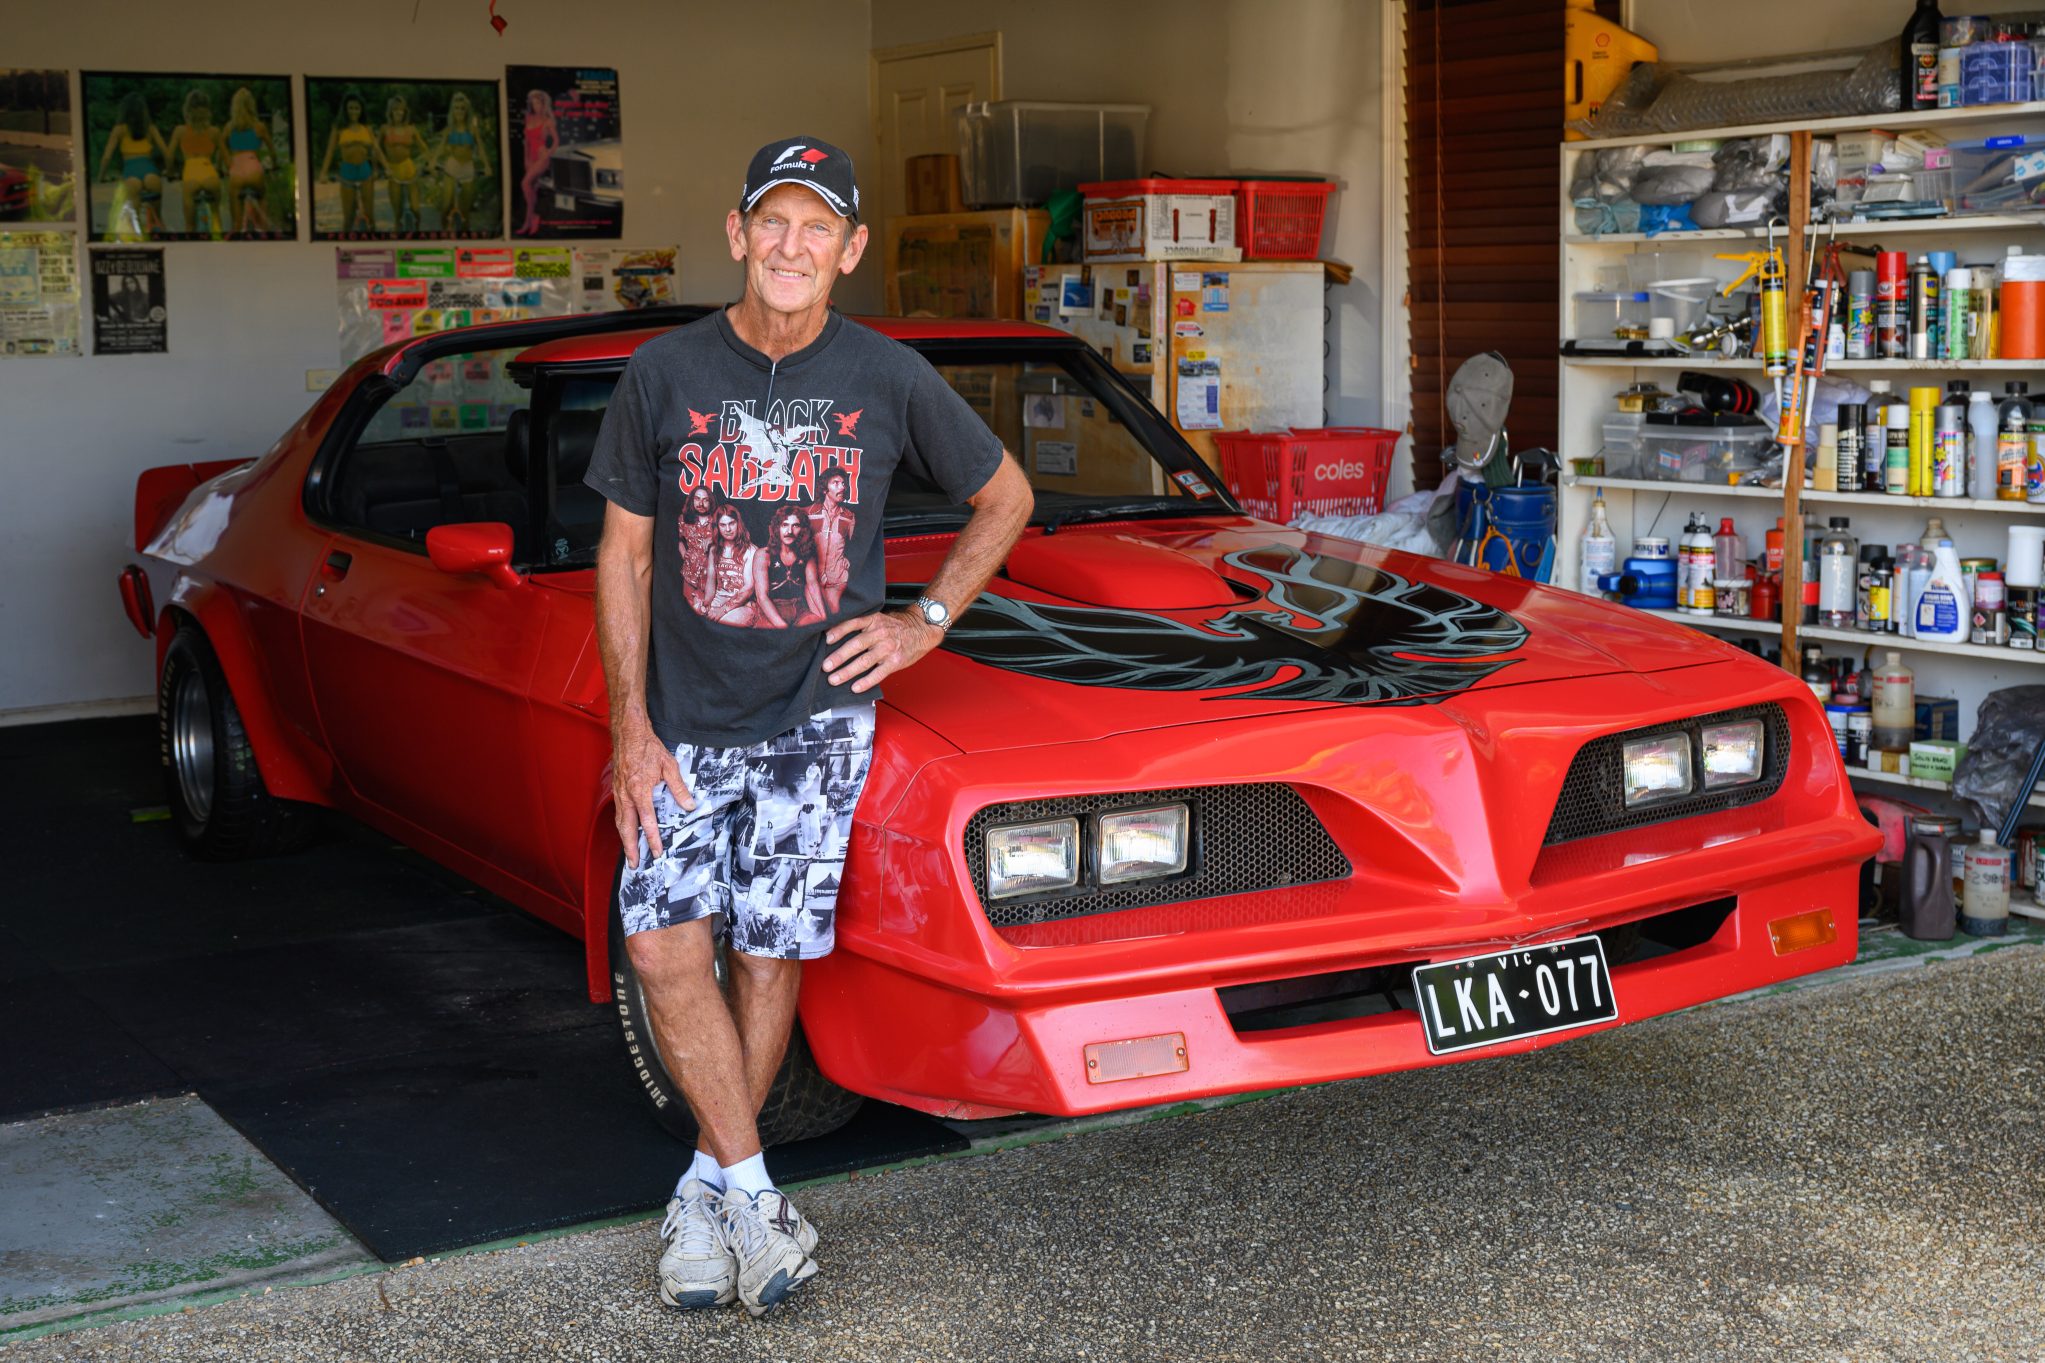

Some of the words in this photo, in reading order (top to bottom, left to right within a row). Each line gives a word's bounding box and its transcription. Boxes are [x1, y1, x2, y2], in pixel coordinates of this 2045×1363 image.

[770, 160, 807, 173] Formula
[718, 398, 834, 445] BLACK
[1314, 458, 1364, 481] coles
[1498, 953, 1532, 970] VIC
[615, 972, 668, 1108] BRIDGESTONE
